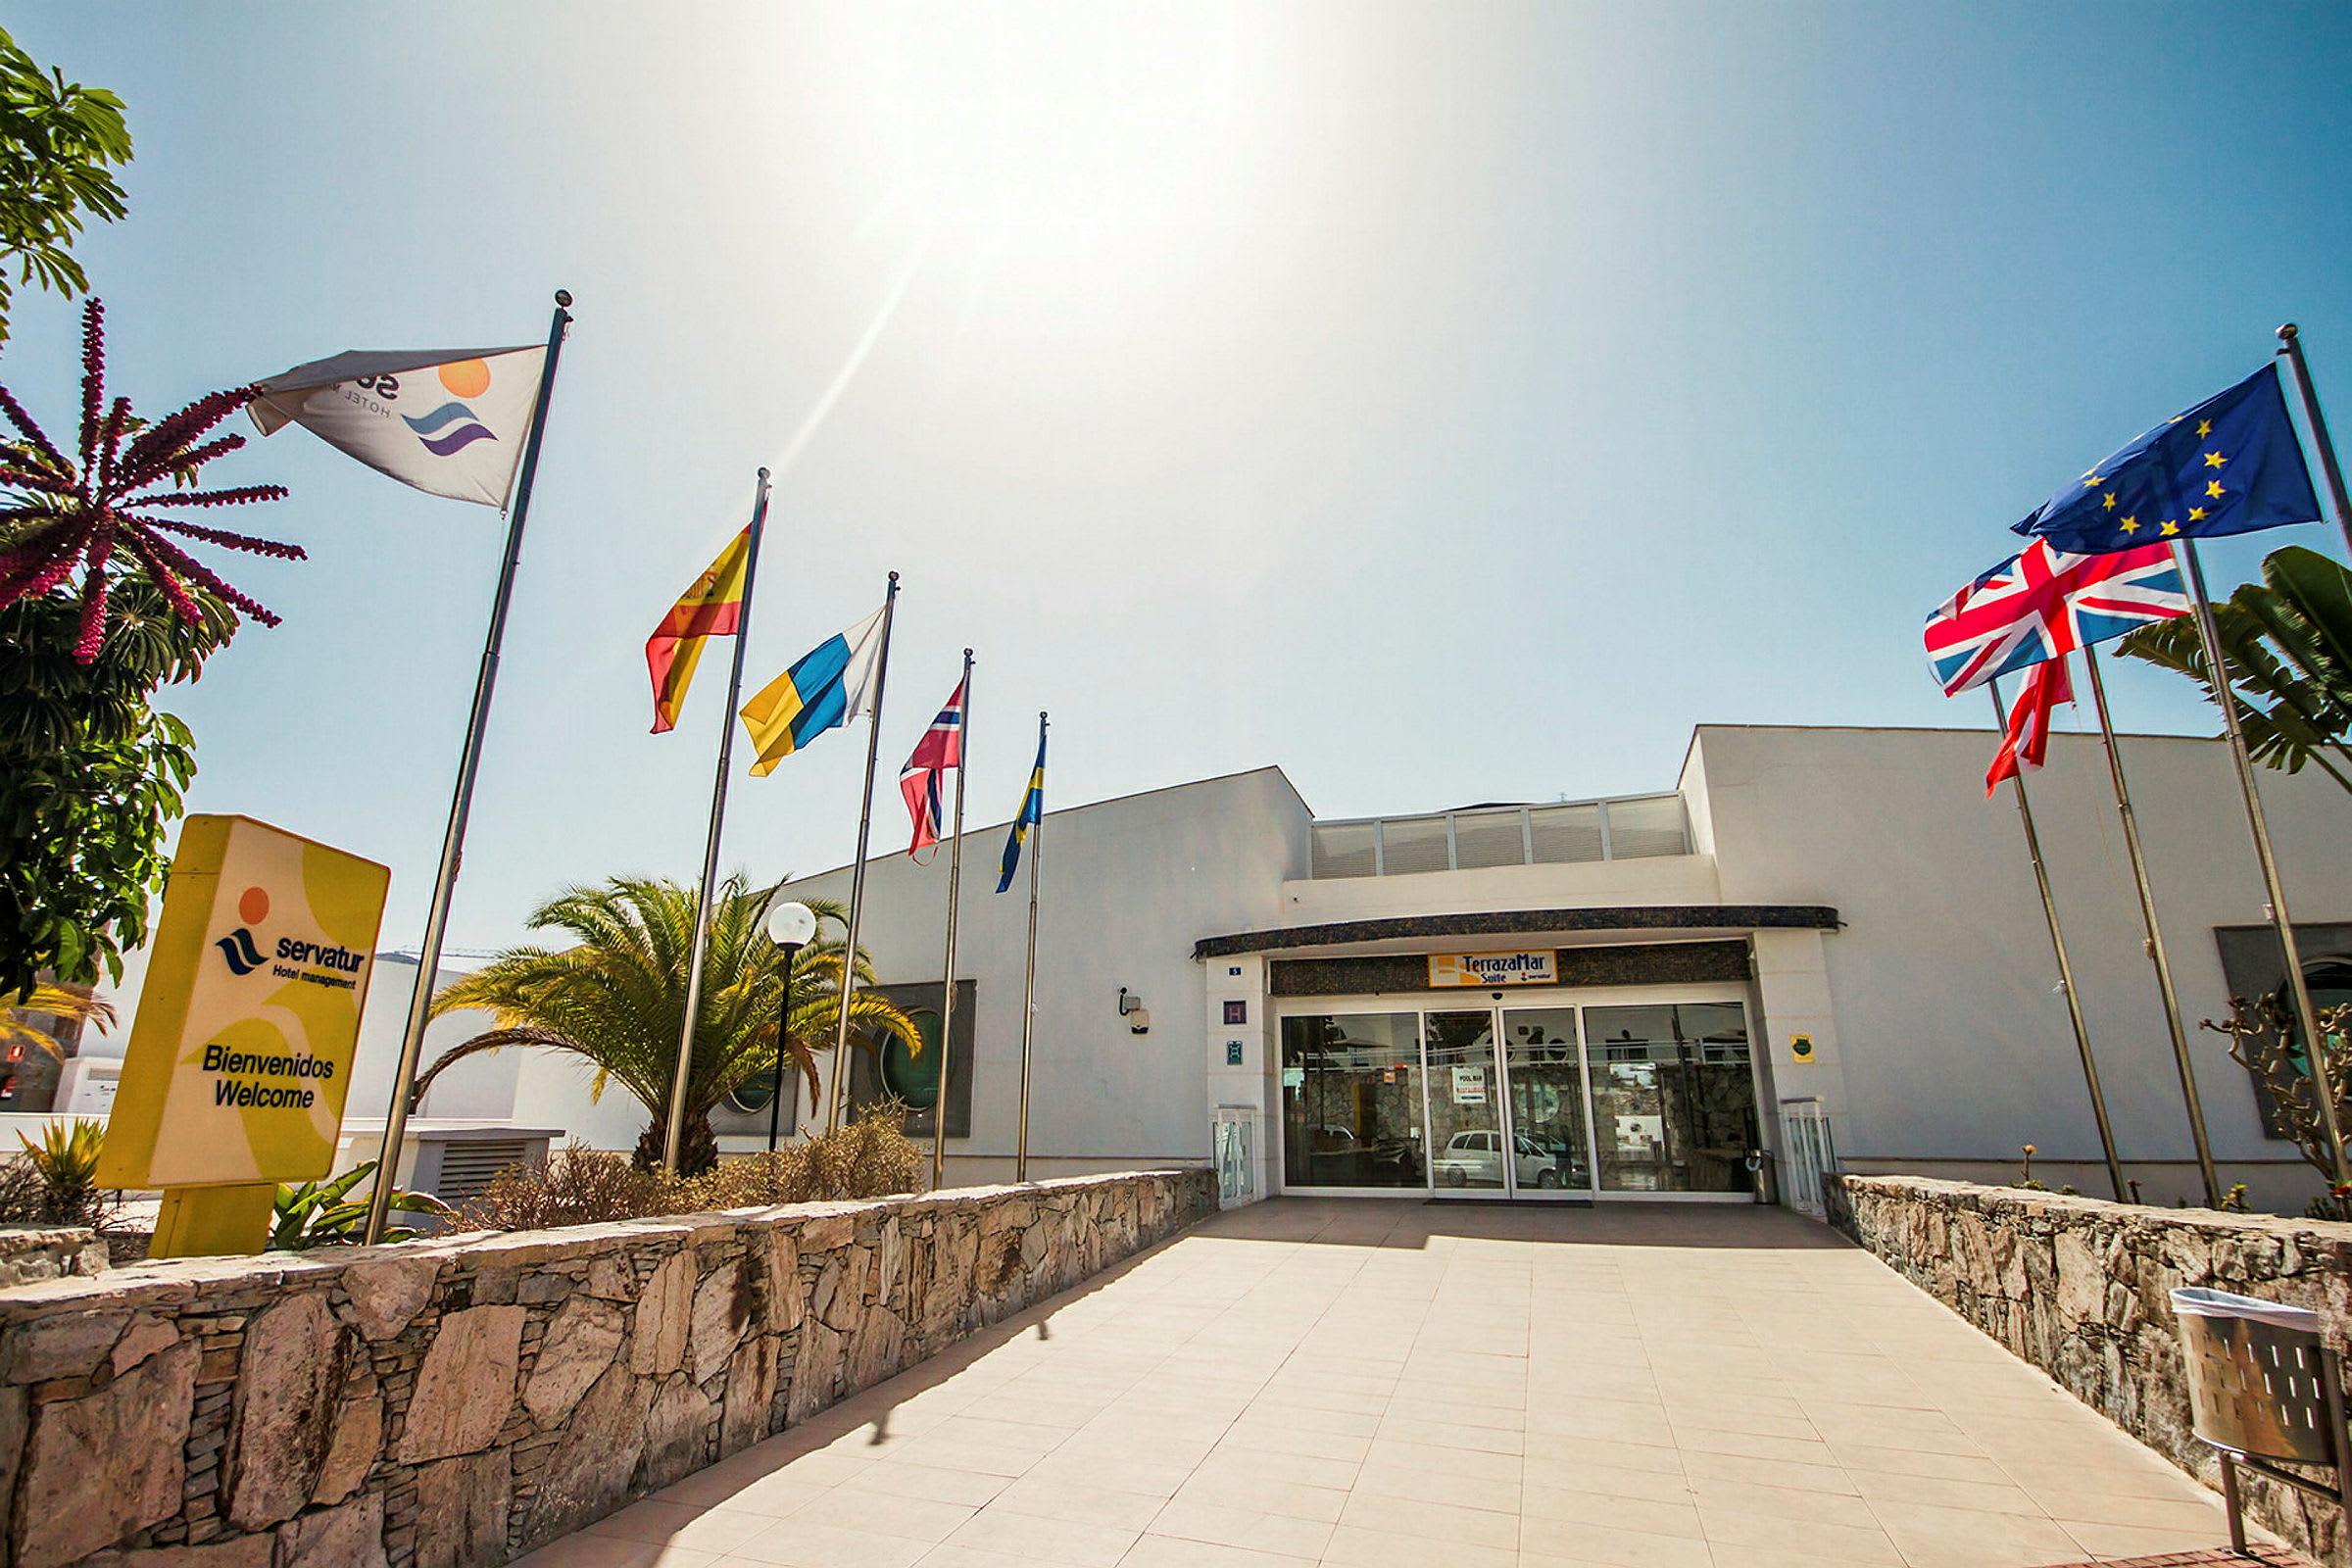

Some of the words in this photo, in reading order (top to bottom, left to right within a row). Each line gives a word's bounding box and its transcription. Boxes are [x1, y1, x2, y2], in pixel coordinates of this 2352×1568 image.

[276, 937, 365, 973] servatur
[1462, 954, 1545, 973] TerrazaMar
[272, 963, 300, 980] Hotel
[301, 971, 357, 990] management
[1481, 972, 1506, 984] Suite
[202, 1044, 334, 1079] Bienvenidos
[216, 1079, 315, 1108] Welcome
